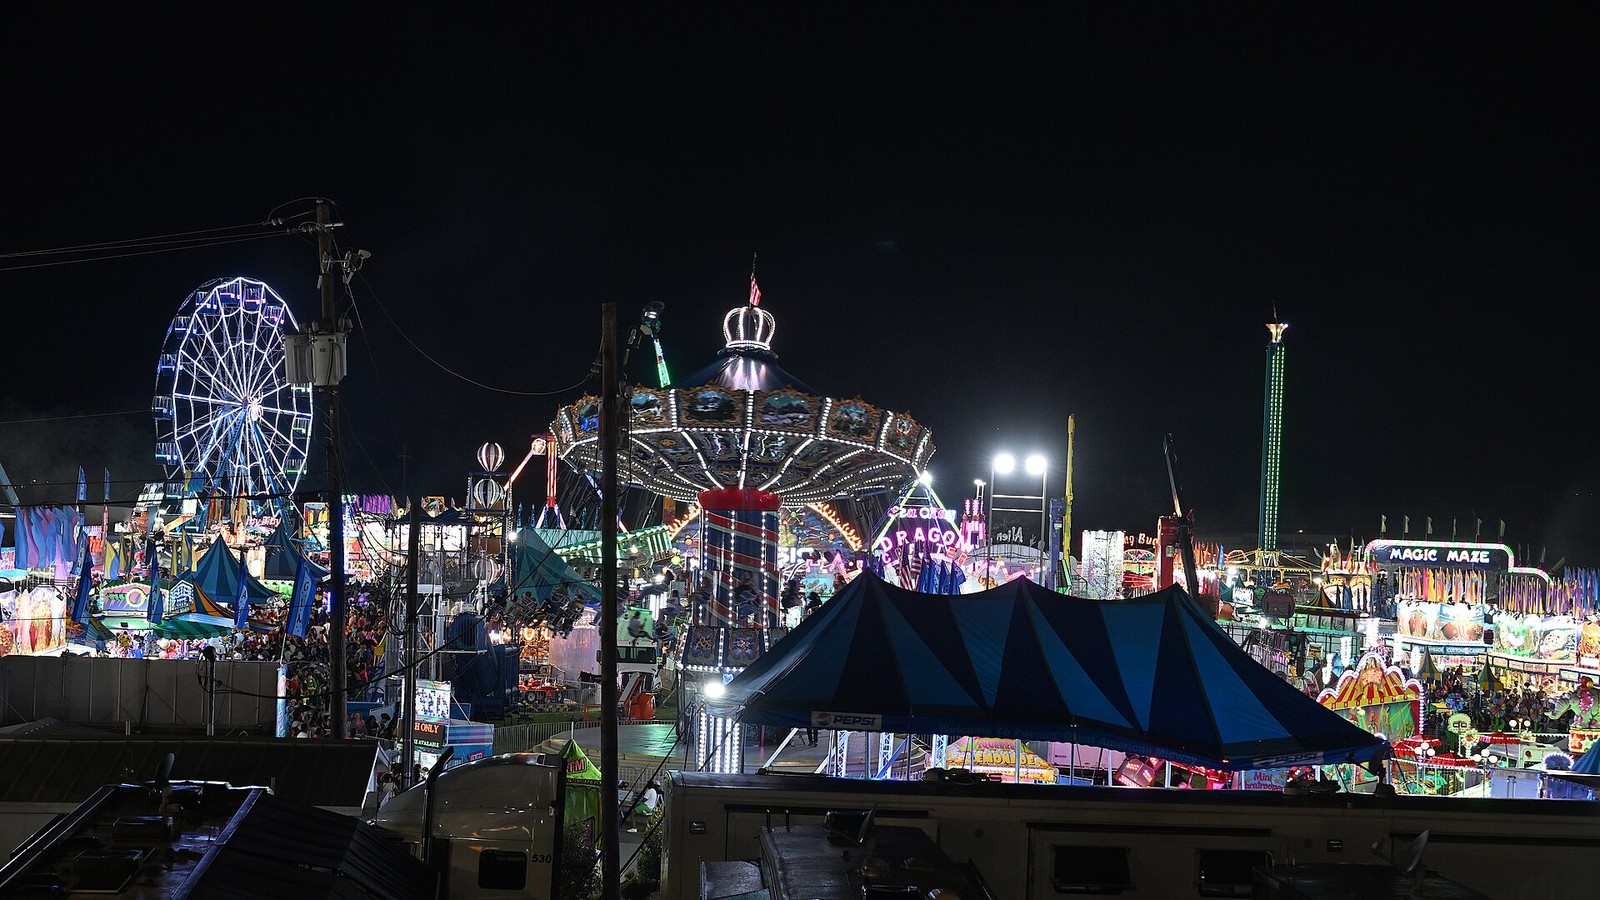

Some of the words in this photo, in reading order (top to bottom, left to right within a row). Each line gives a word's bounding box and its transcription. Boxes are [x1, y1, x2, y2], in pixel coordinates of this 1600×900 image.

[880, 527, 968, 552] DRAGON
[1389, 548, 1438, 561] MAGIC
[1446, 550, 1490, 563] MAZE
[833, 715, 876, 726] PEPSI
[420, 723, 440, 734] ONLY
[940, 723, 992, 735] Welcome
[997, 726, 1011, 736] To
[1098, 736, 1153, 755] American
[566, 758, 585, 773] TM
[1254, 771, 1272, 781] Mini
[532, 854, 552, 864] 530
